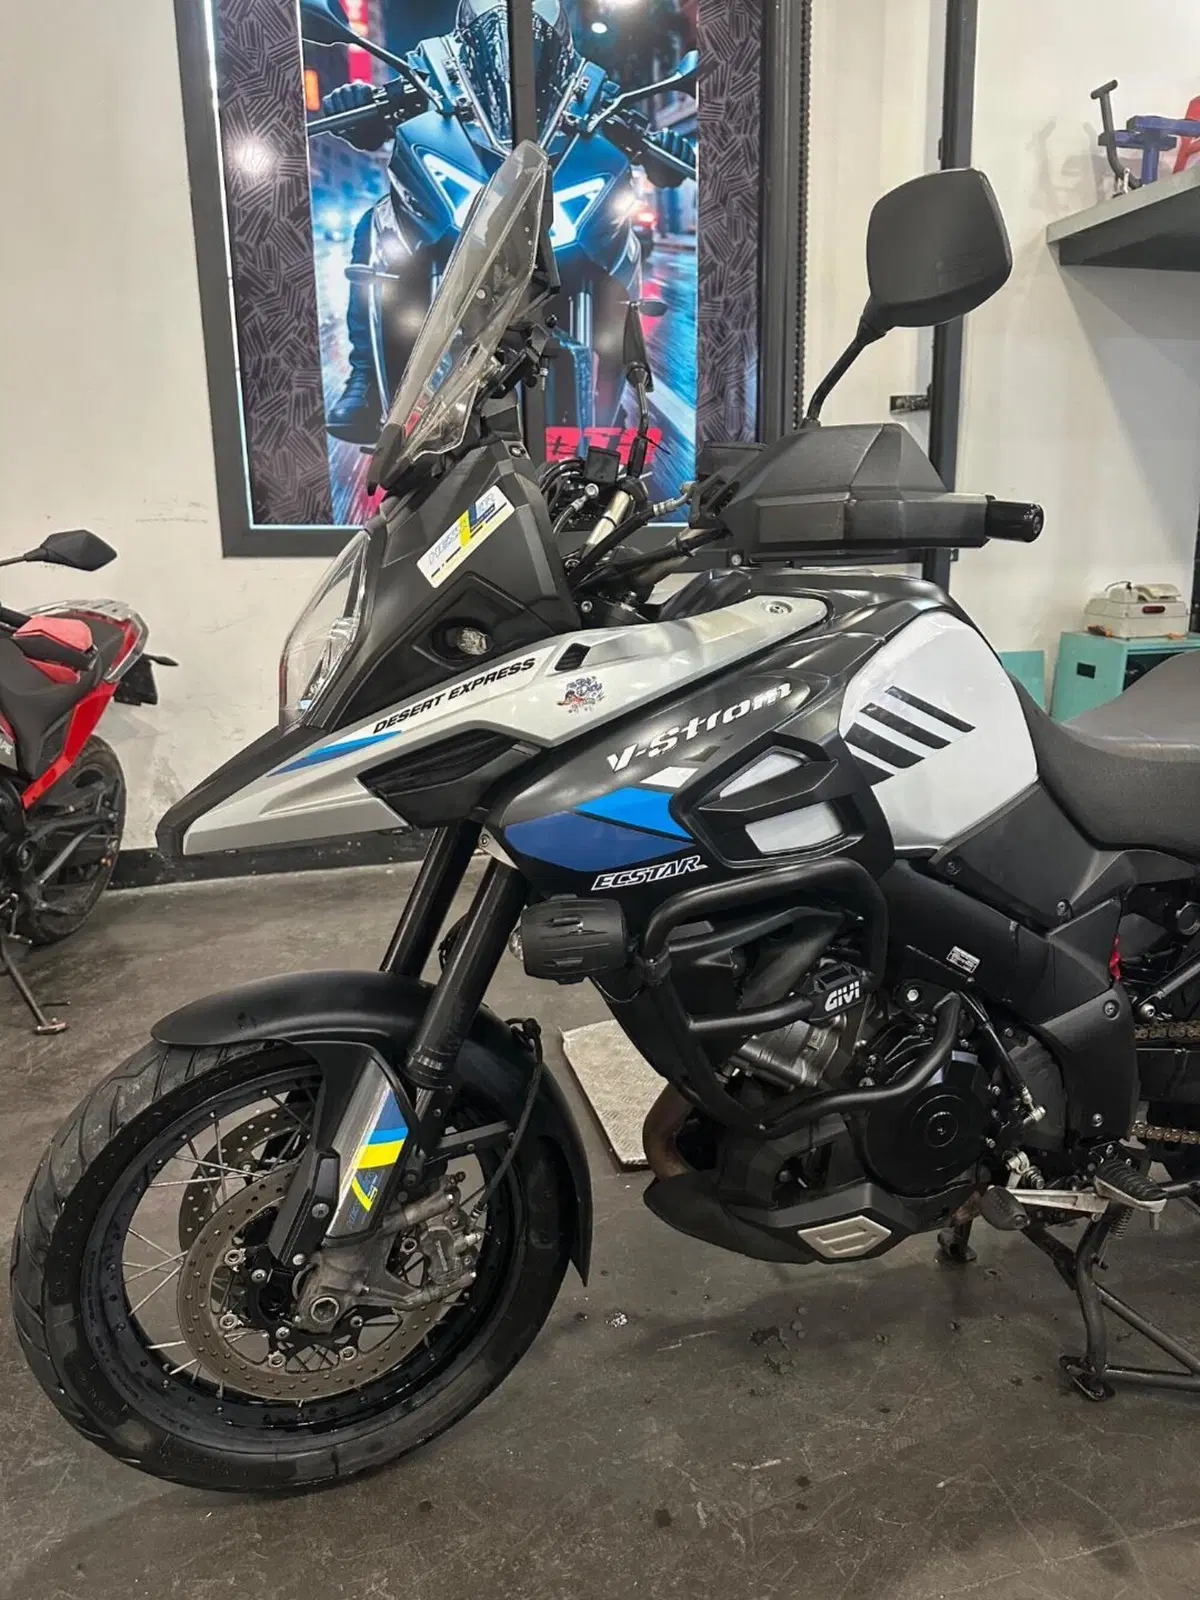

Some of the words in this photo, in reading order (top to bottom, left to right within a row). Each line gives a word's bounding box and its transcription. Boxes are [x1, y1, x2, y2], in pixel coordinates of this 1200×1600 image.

[373, 693, 446, 734] DESERT
[448, 657, 536, 701] EXPRESS
[606, 682, 793, 772] V-Strom
[591, 854, 709, 891] ECSTAR
[824, 980, 860, 1012] GIVI
